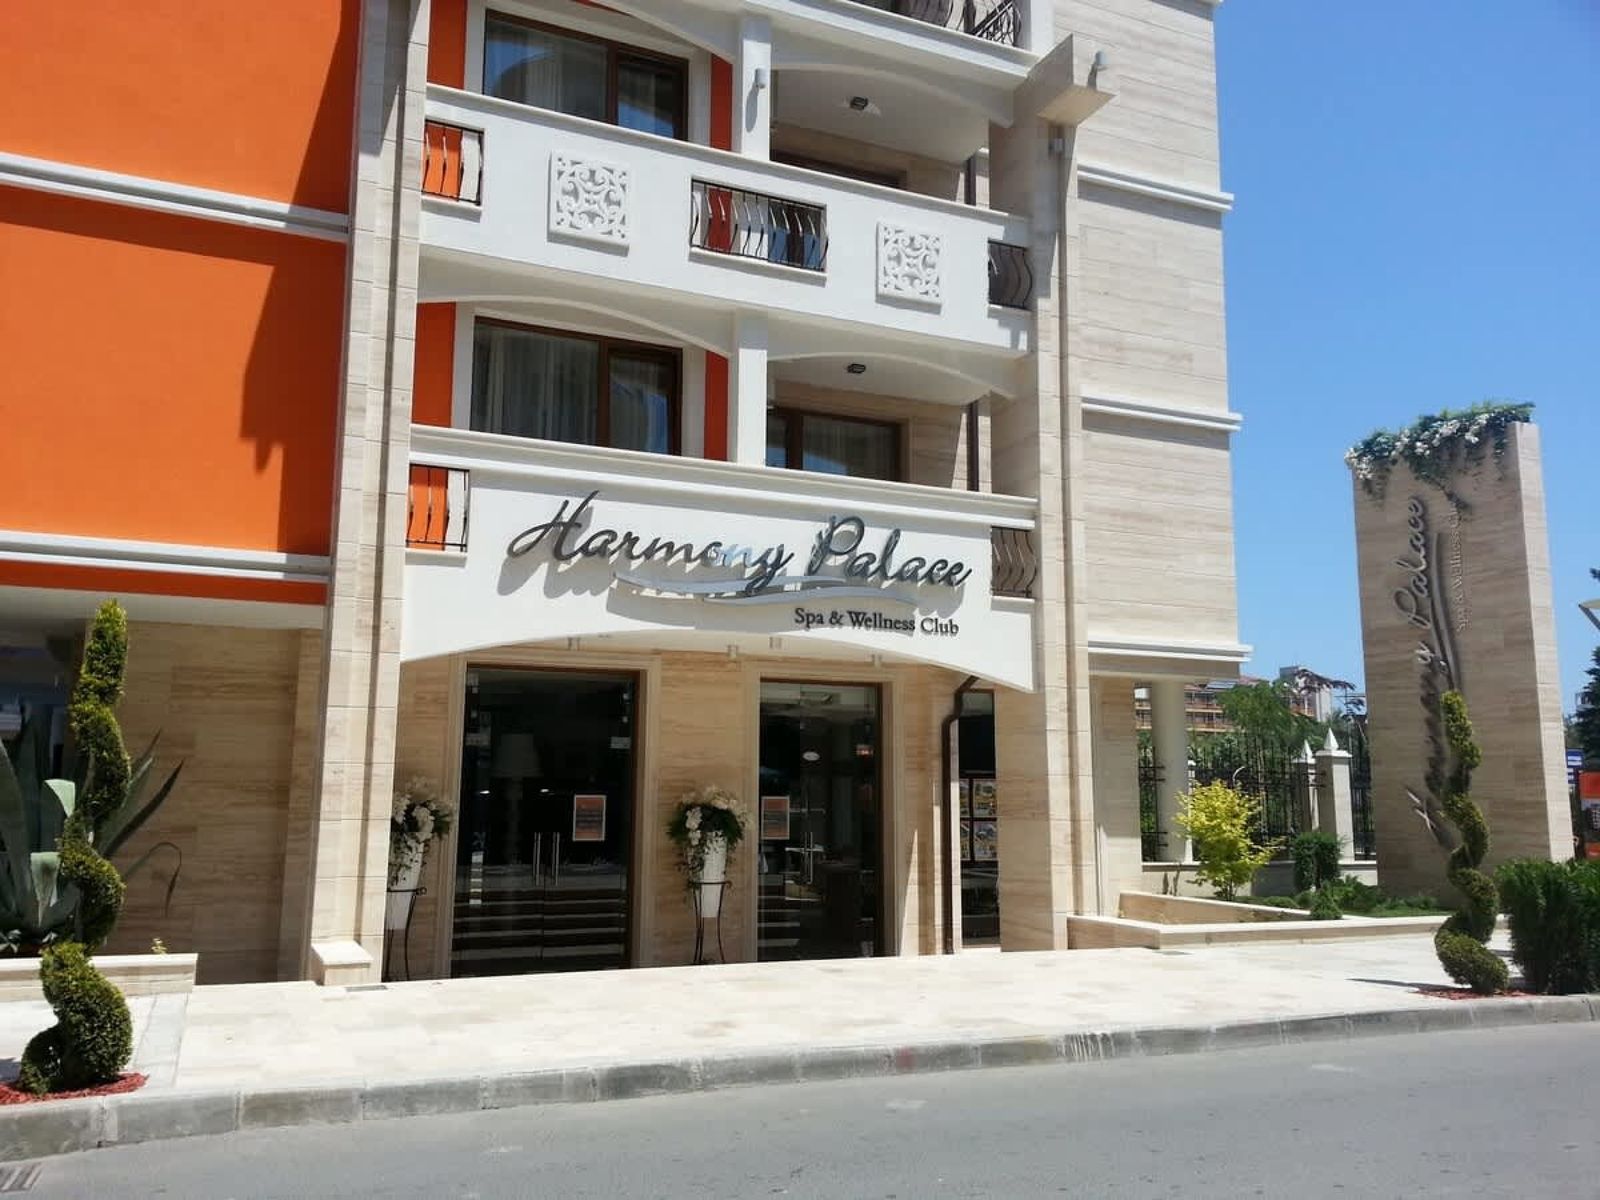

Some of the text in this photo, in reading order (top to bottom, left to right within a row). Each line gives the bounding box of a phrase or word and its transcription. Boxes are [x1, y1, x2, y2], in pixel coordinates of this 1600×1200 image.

[506, 490, 973, 592] Harmony Palace
[1391, 498, 1431, 629] Palace
[794, 607, 960, 635] Spa & Wellness Club
